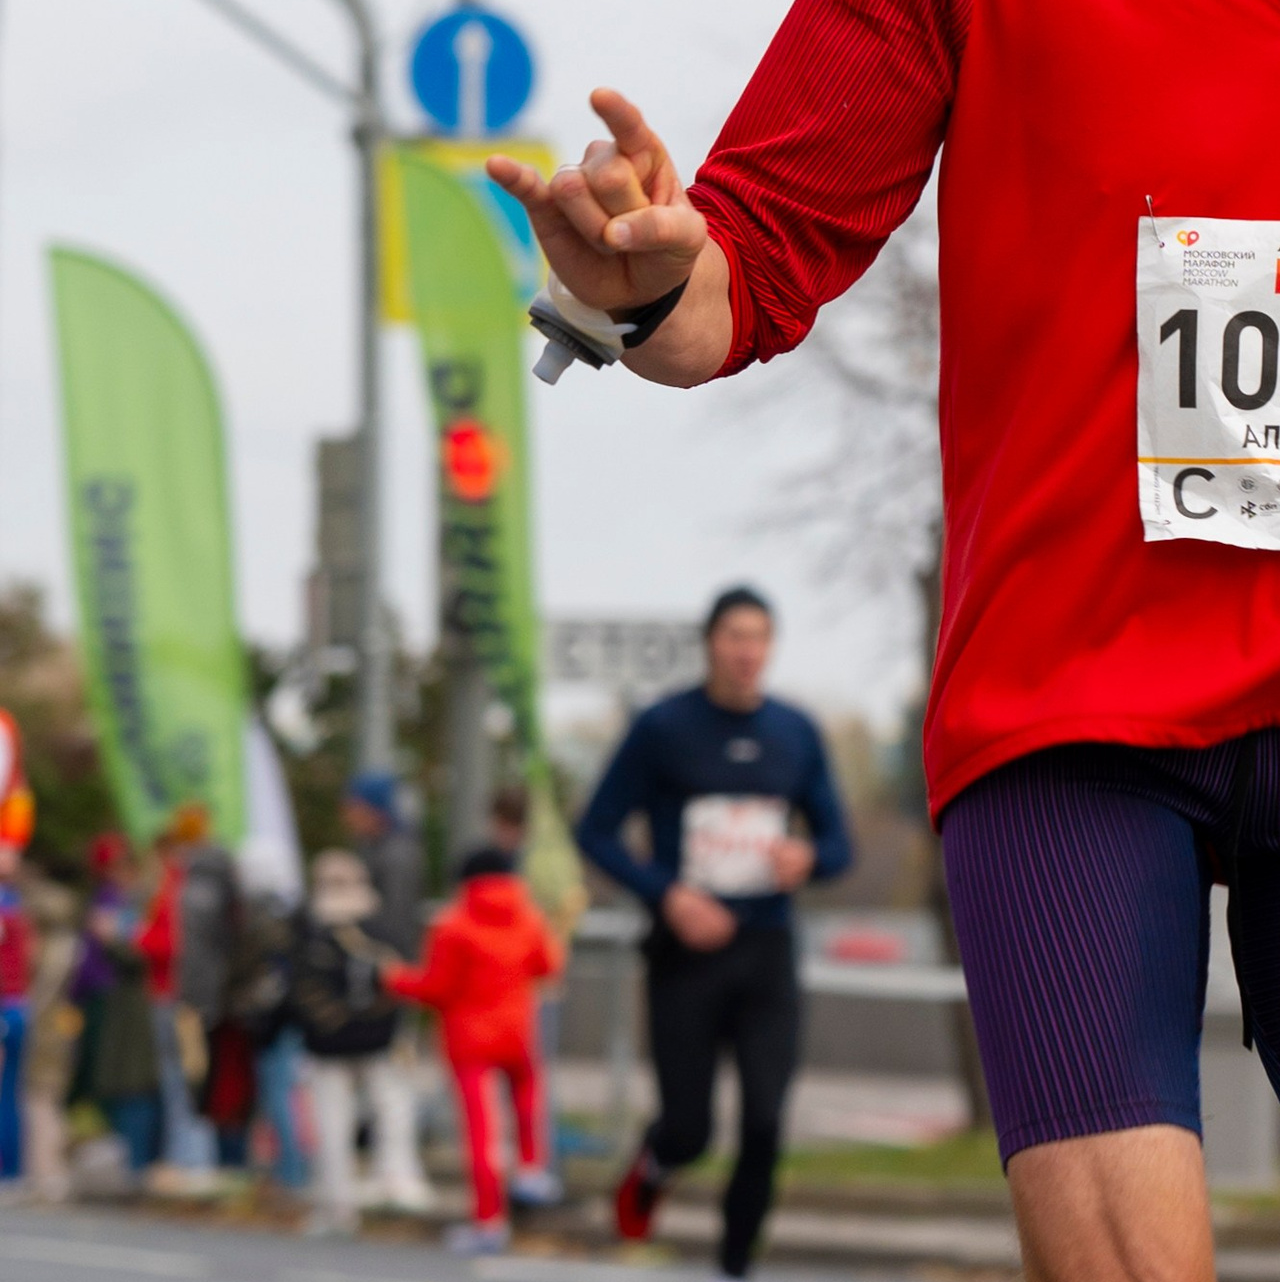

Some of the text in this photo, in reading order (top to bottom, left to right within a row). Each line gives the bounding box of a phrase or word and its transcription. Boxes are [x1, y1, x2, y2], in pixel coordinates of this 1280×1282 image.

[1183, 250, 1256, 260] МОСКОВСКИЙ
[1183, 259, 1236, 268] МАРАФОН
[1182, 268, 1229, 277] MOSCOW
[1182, 277, 1239, 287] MARATHON
